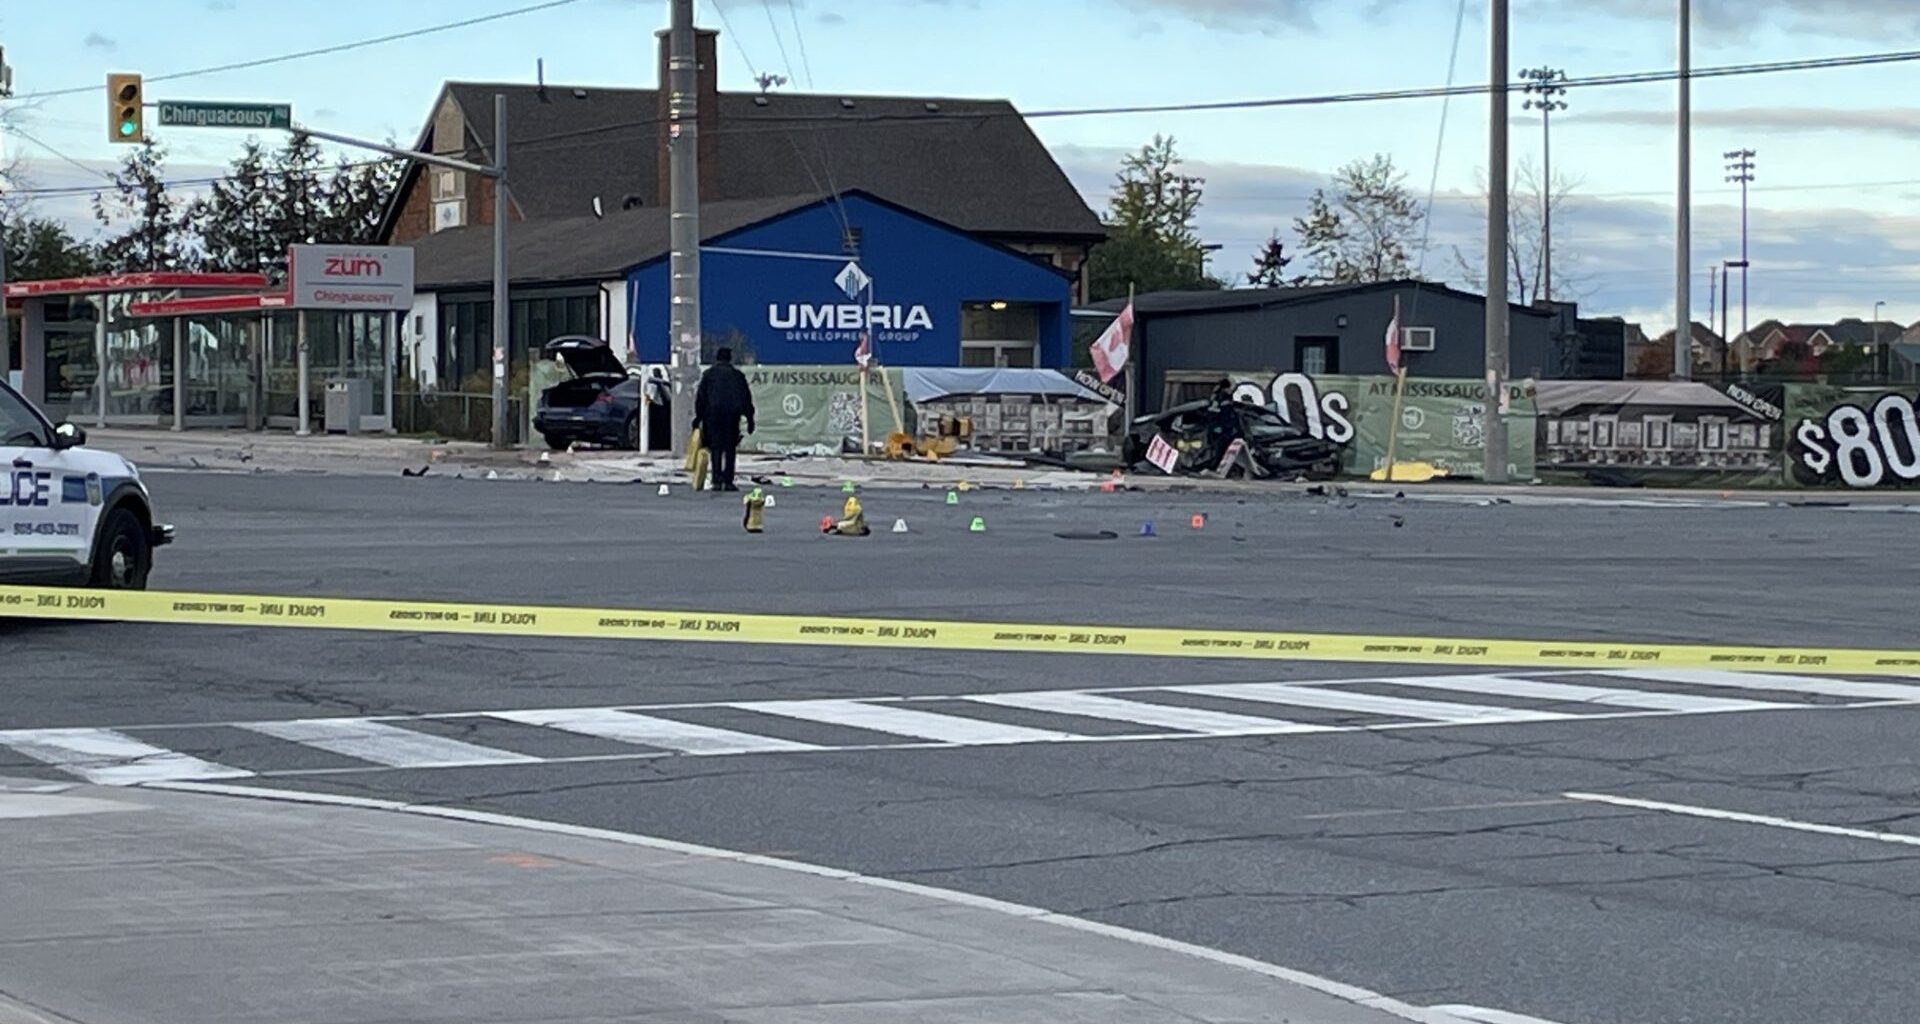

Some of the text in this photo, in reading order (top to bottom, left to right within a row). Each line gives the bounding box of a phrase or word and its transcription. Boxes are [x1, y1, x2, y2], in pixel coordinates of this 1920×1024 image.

[161, 104, 273, 128] Chinguacousy
[769, 303, 933, 330] UMBRIA
[785, 331, 920, 341] DEVELOPME GROUP
[751, 371, 769, 385] AT
[1368, 383, 1387, 396] AT
[1390, 383, 1484, 399] MISSISSAUG
[0, 471, 51, 506] ICE
